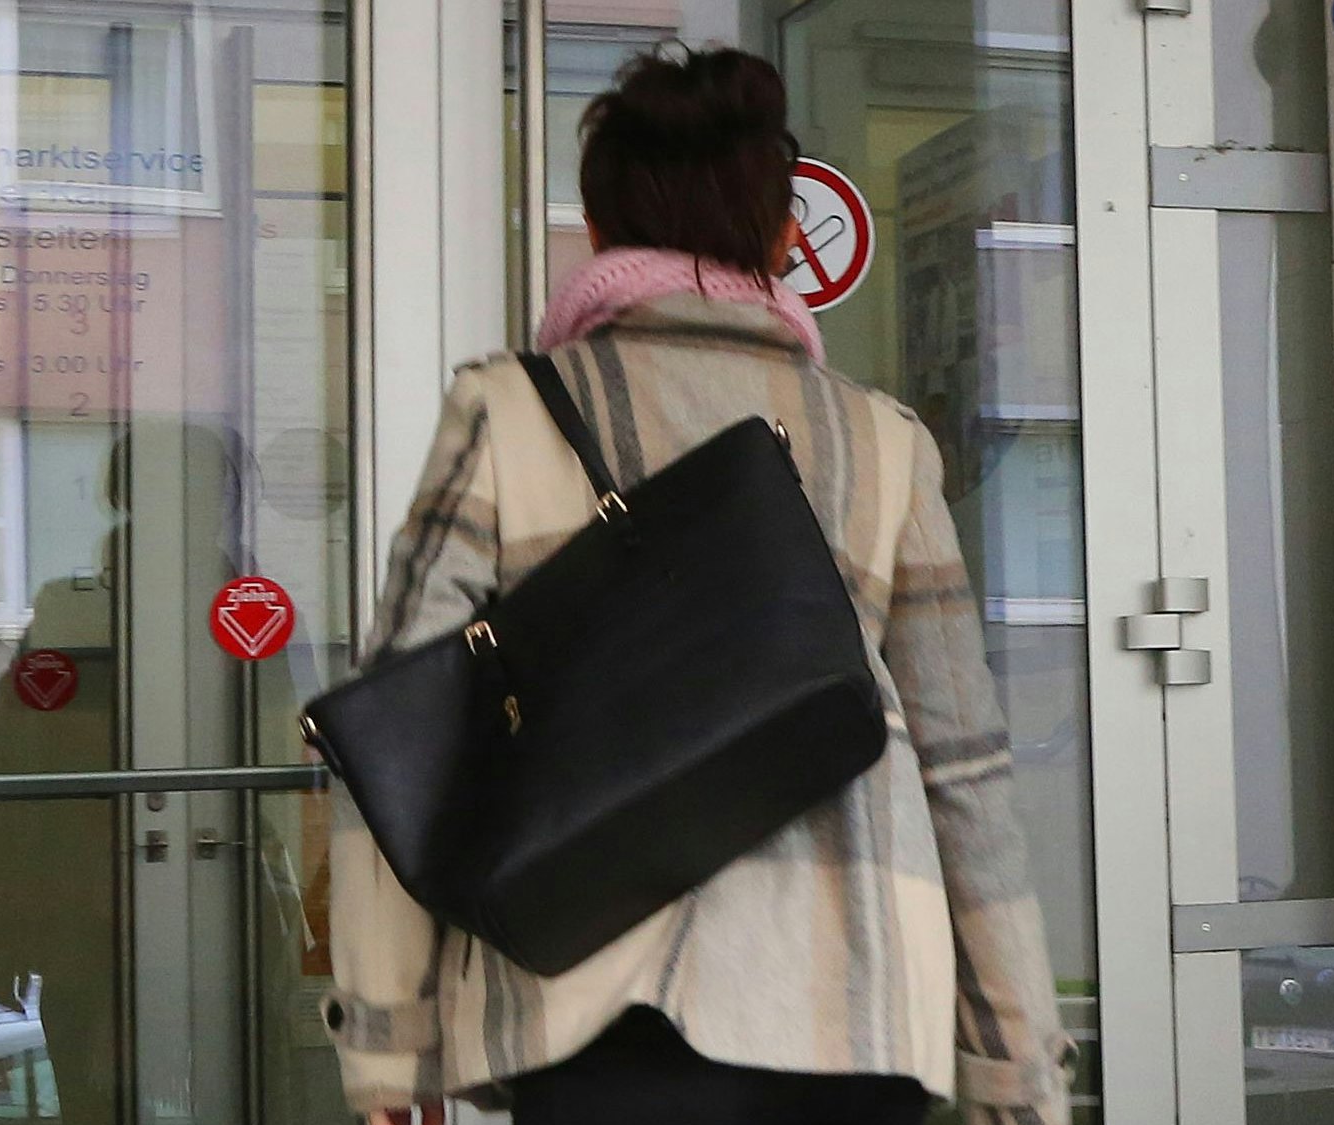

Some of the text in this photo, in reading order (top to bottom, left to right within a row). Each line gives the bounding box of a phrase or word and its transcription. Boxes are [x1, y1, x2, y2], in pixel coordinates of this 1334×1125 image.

[1, 265, 151, 291] Donnersag
[17, 293, 89, 312] 5.30
[17, 355, 87, 375] 3.00
